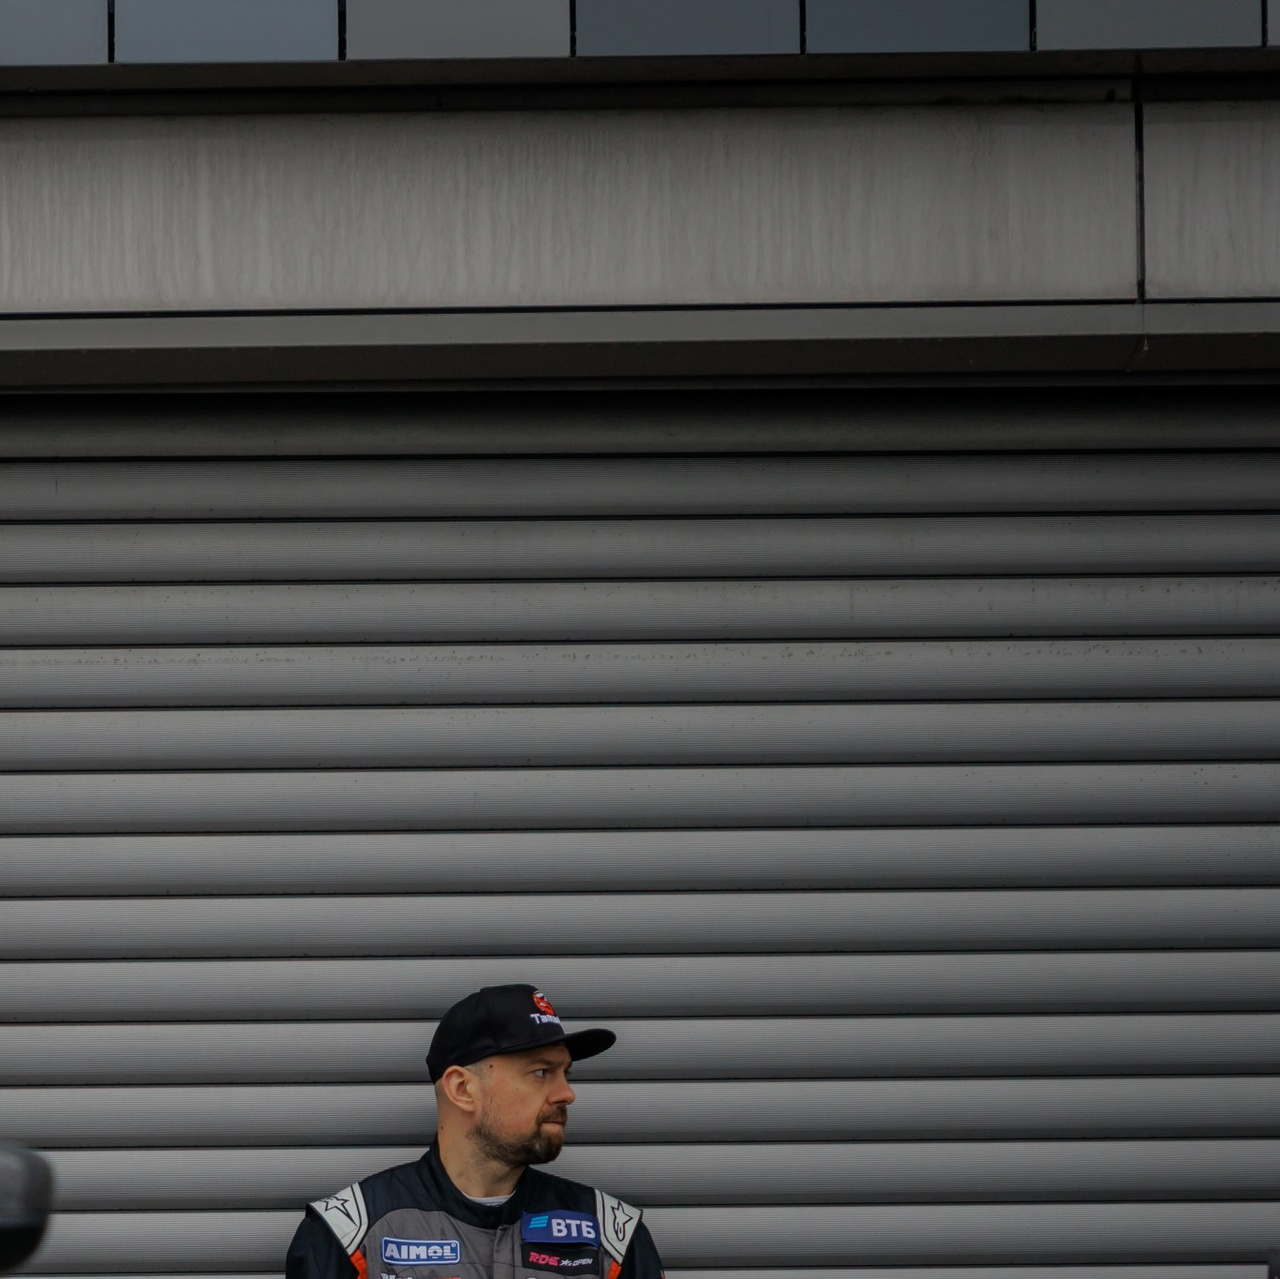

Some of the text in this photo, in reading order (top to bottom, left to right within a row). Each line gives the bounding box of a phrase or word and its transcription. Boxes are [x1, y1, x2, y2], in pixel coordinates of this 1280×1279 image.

[551, 1218, 596, 1239] ВТБ
[384, 1243, 457, 1260] AIMOL
[528, 1251, 560, 1267] RDS
